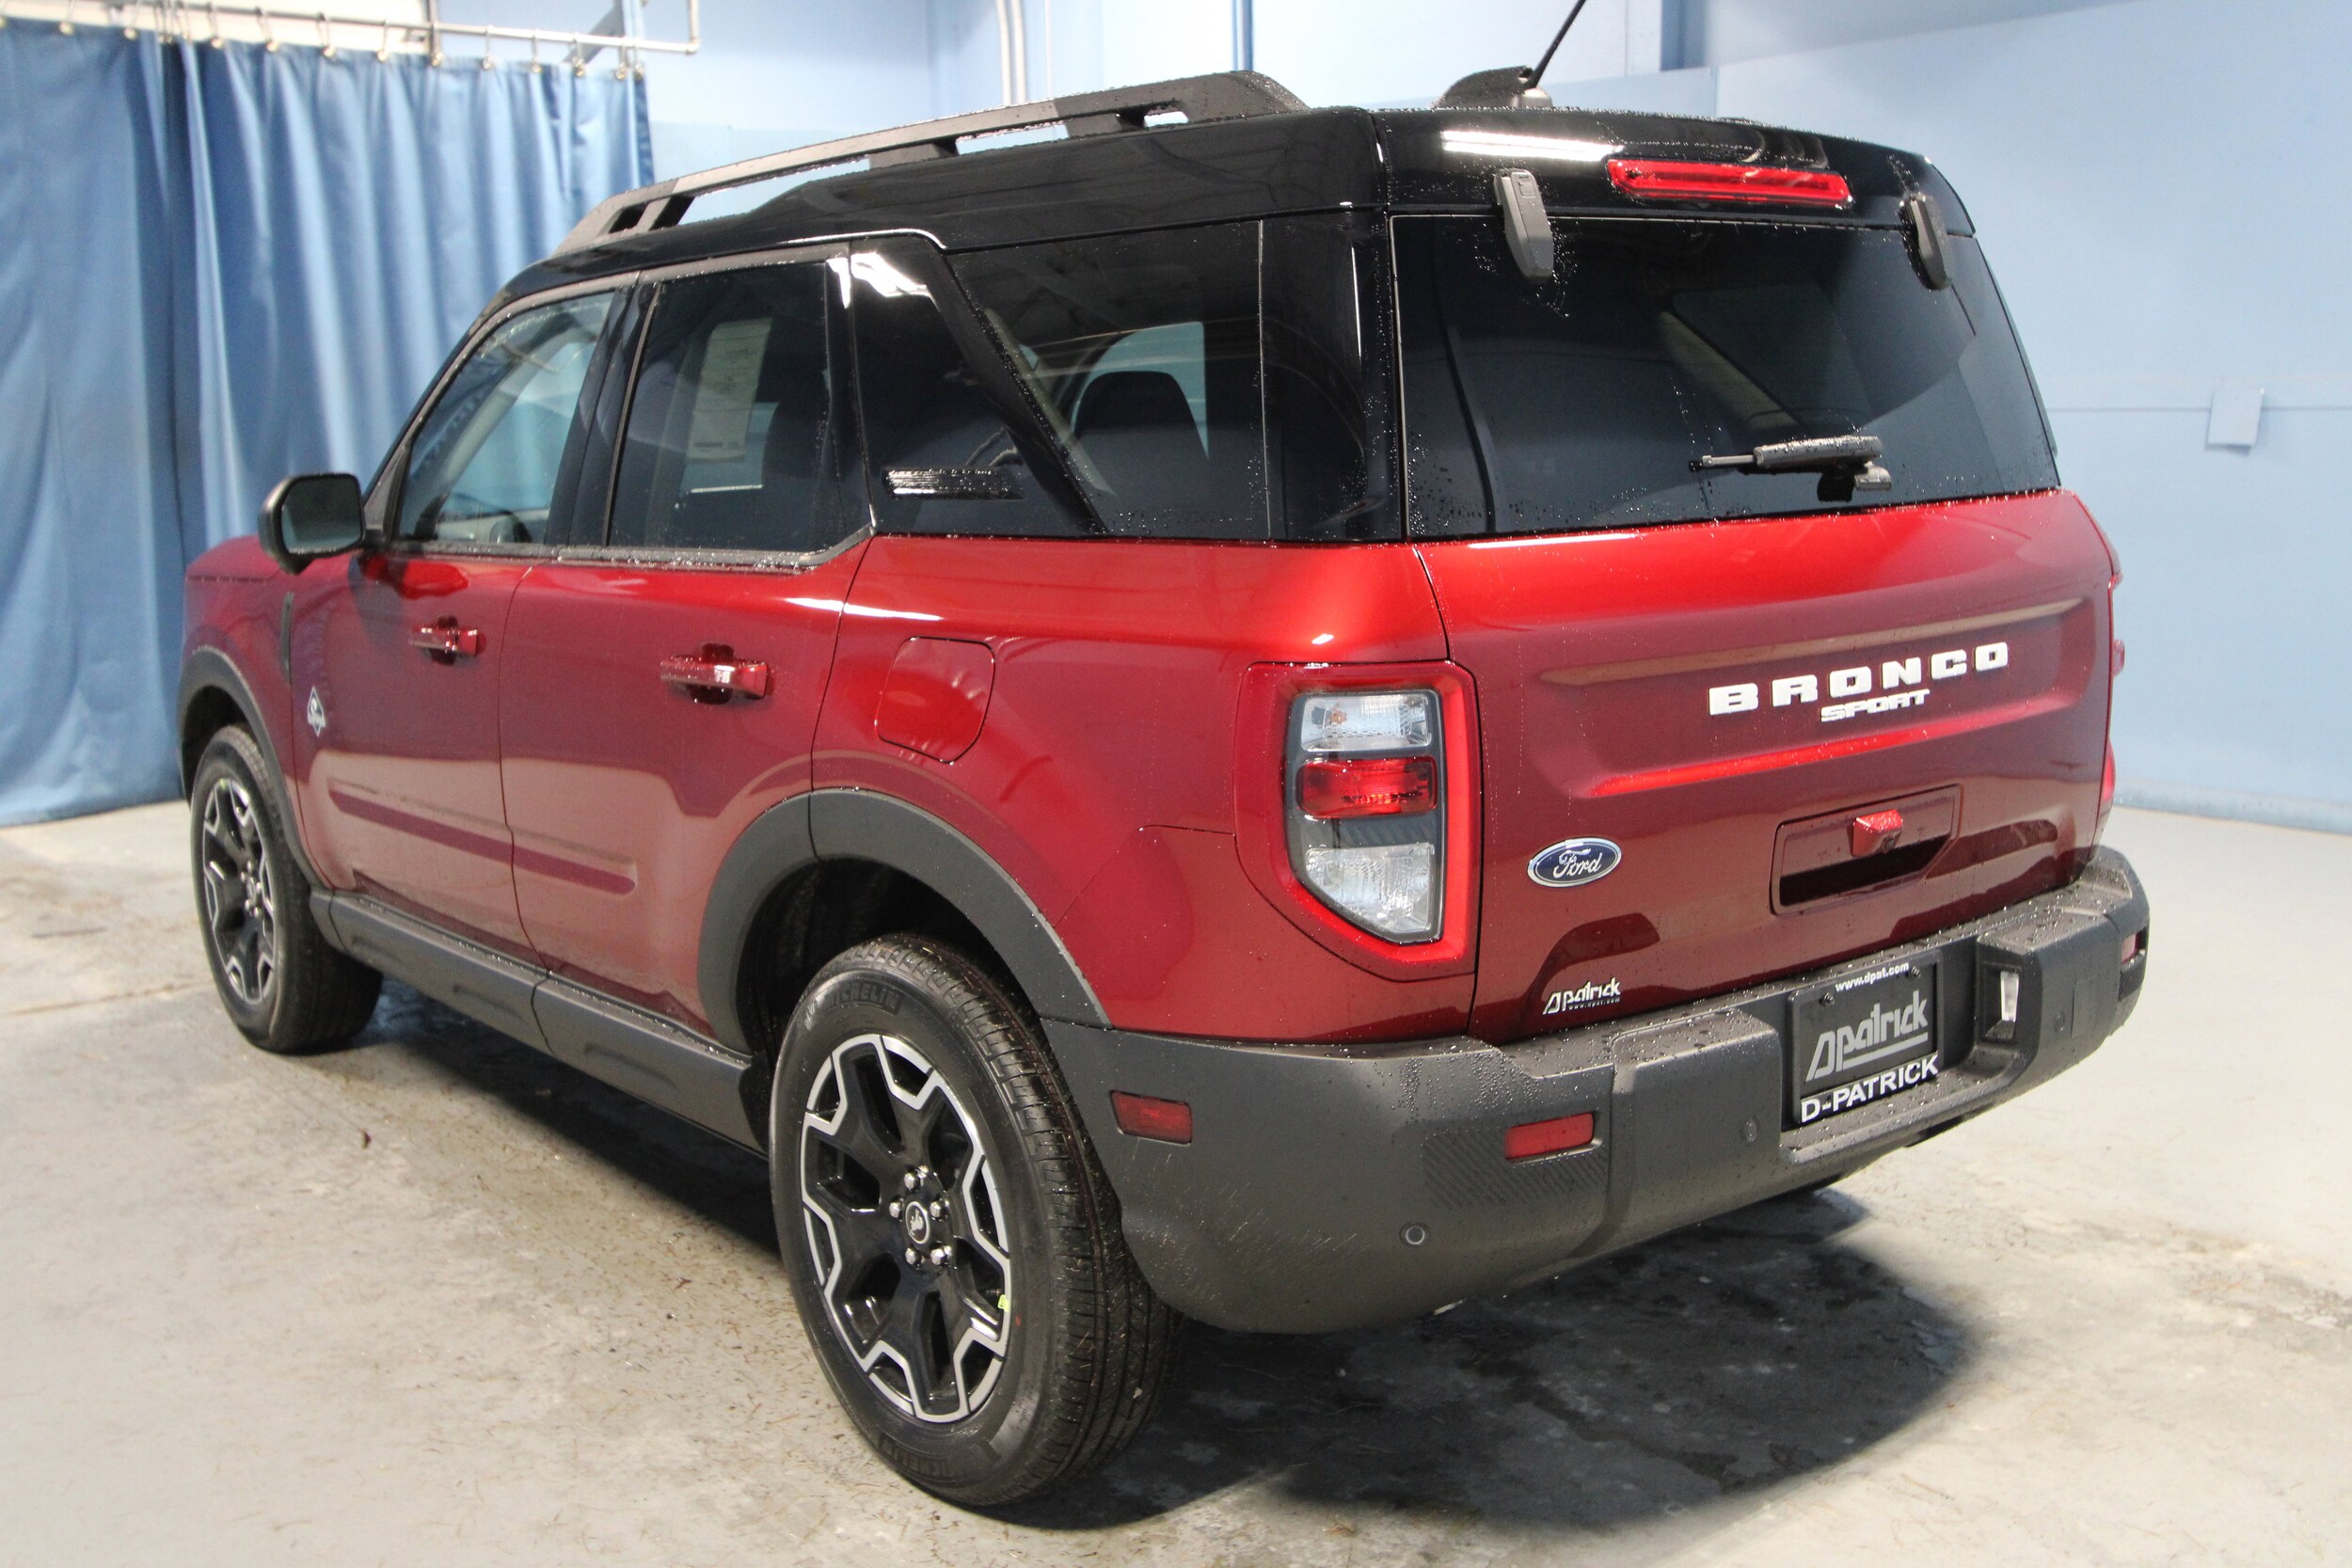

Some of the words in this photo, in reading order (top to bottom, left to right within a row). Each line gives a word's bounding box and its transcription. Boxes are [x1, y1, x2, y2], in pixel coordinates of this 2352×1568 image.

[1708, 641, 2009, 716] BRONCO
[1820, 689, 1931, 722] SPORT
[1552, 848, 1603, 879] Ford
[1835, 962, 1910, 992] www.dpat.com
[1801, 1053, 1939, 1123] D-PATRICK
